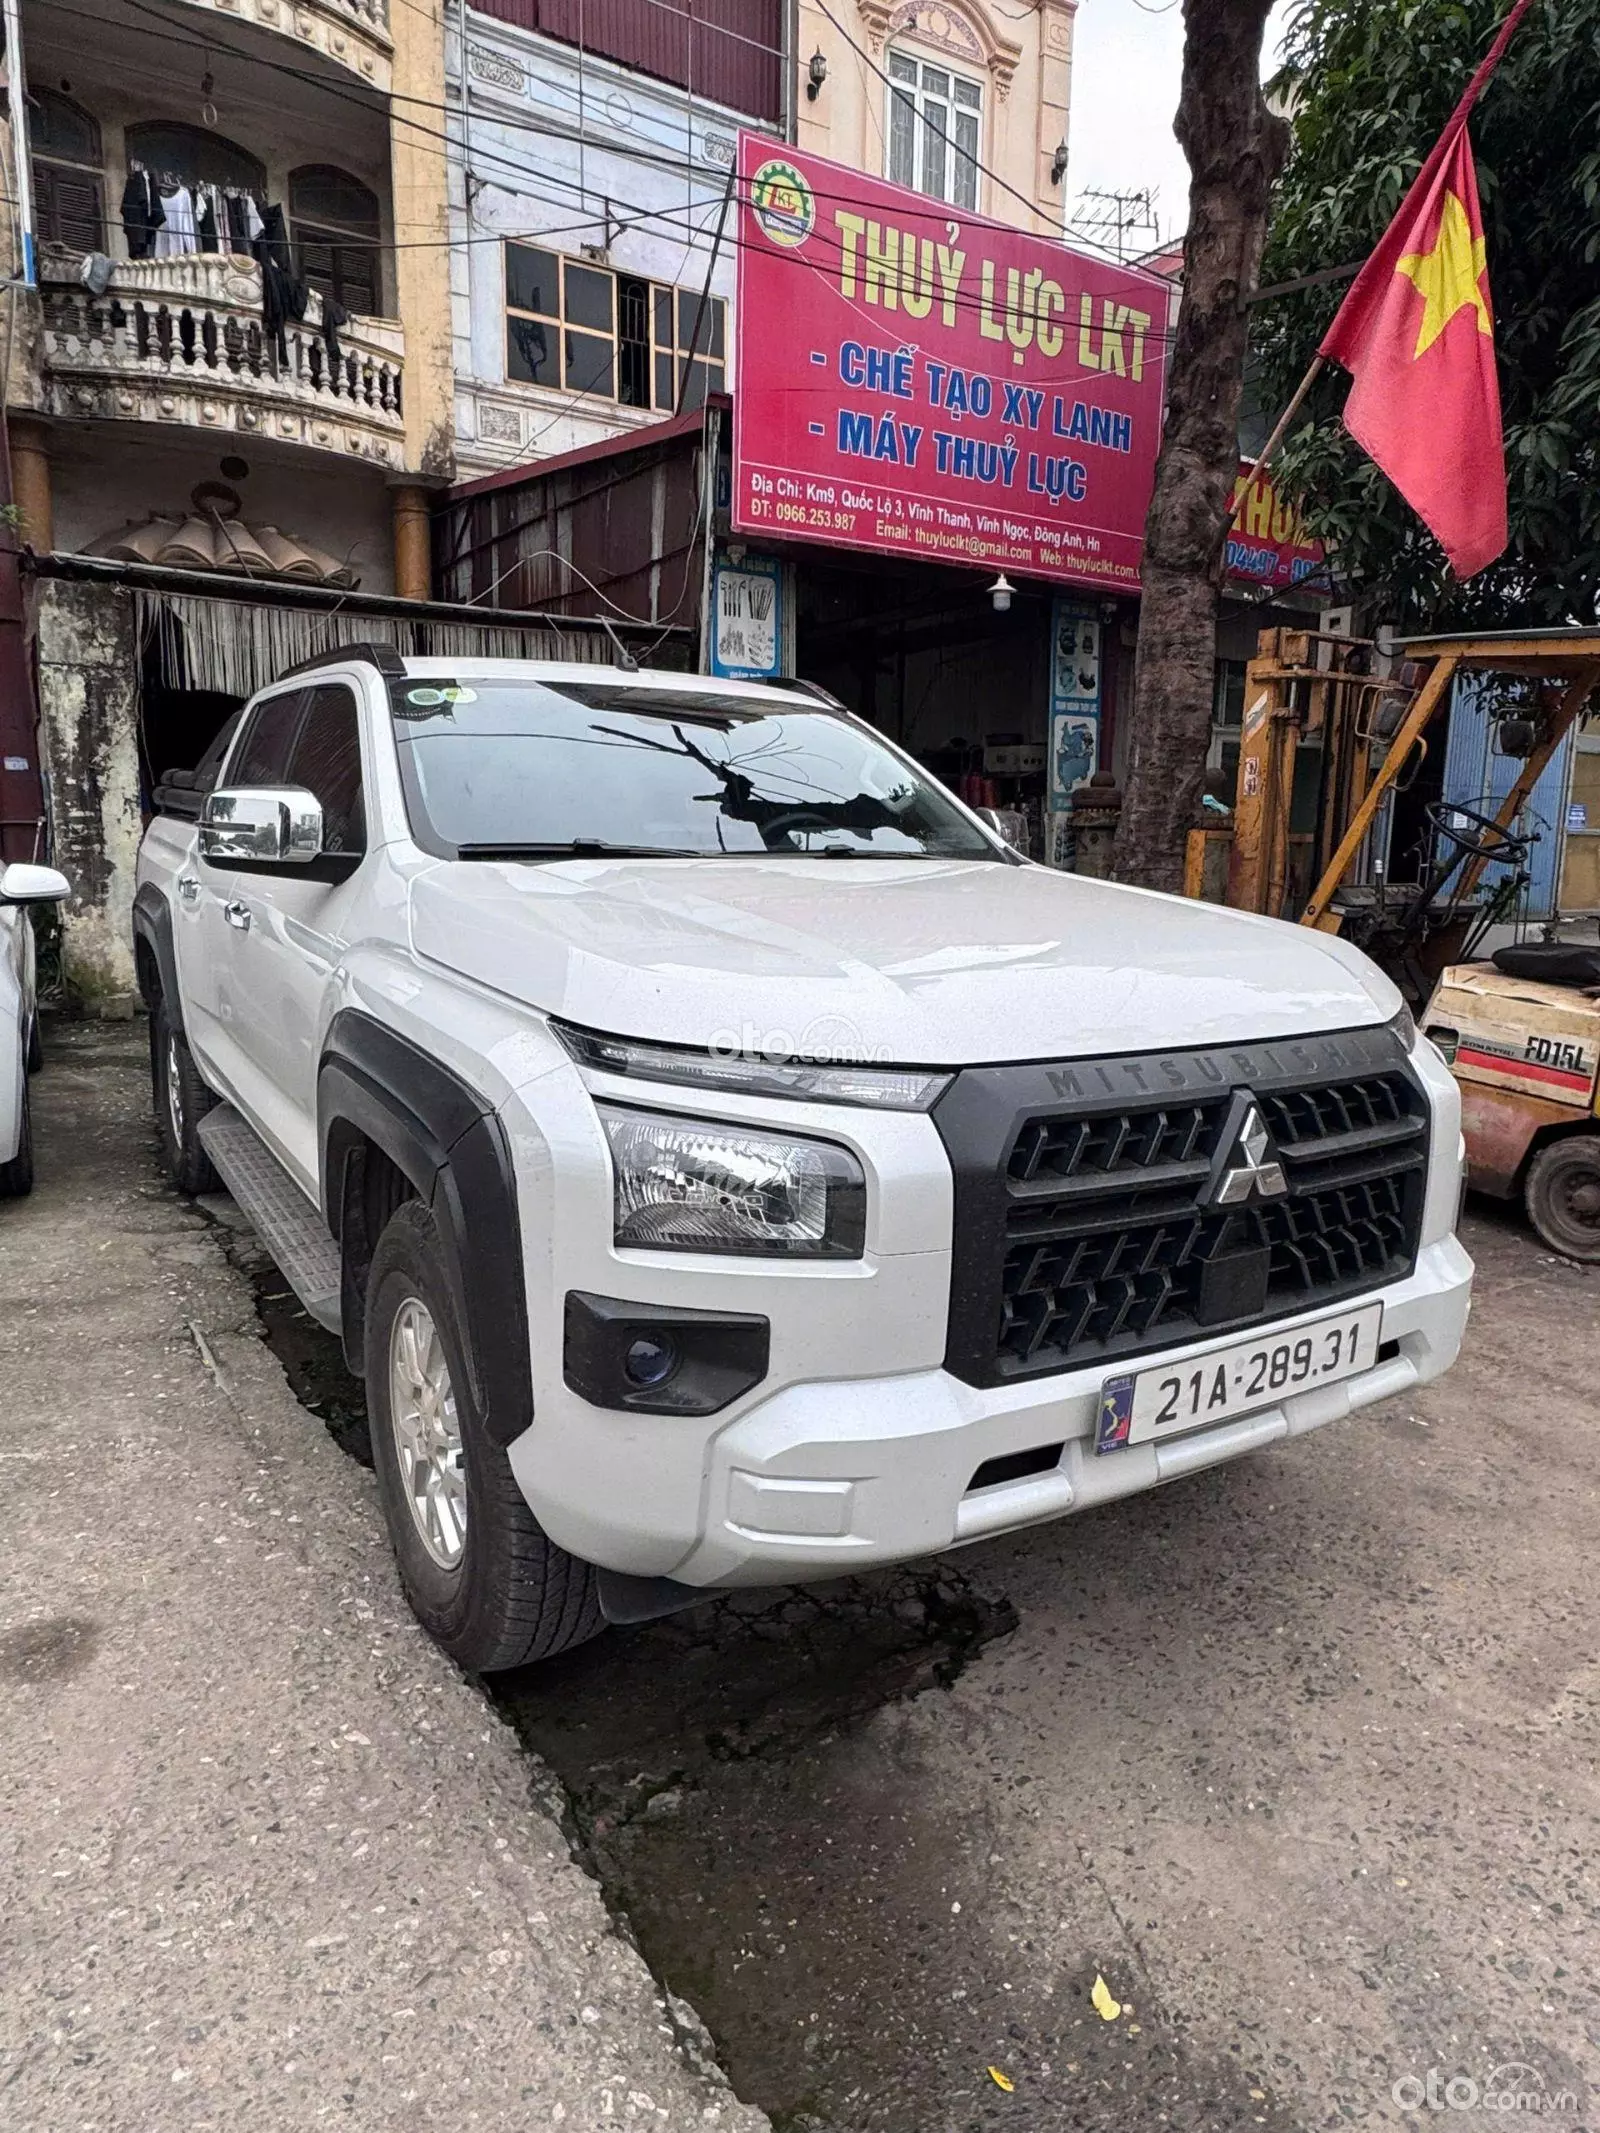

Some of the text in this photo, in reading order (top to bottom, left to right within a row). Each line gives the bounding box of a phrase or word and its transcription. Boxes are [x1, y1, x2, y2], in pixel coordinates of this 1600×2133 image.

[834, 208, 1151, 383] THUỶ LỰC LKT
[839, 341, 919, 400] CHẾ
[924, 361, 993, 421] TẠO
[1001, 382, 1046, 431] XY
[1053, 395, 1132, 454] LANH
[837, 408, 923, 468] MÁY
[933, 430, 1019, 487] THUỶ
[1027, 452, 1087, 506] LỰC
[751, 473, 773, 496] Địa
[807, 483, 838, 507] Km9,
[842, 489, 874, 511] Quốc
[895, 502, 905, 520] 3,
[908, 503, 934, 523] Vĩnh
[936, 507, 974, 532] Thanh,
[976, 514, 1001, 534] Vĩnh
[1003, 519, 1032, 542] Ngọc,
[1062, 530, 1085, 550] Anh,
[1087, 536, 1100, 552] Hn
[751, 498, 773, 518] ĐT:
[776, 502, 856, 532] 0966.253.987
[876, 520, 912, 541] Email:
[915, 527, 1032, 562] thuyluclkt@gmail.com
[1039, 547, 1065, 568] Web:
[1044, 1037, 1374, 1099] MITSUBISHI
[1523, 1035, 1588, 1074] FD15L
[1155, 1322, 1360, 1425] 21A-289.31
